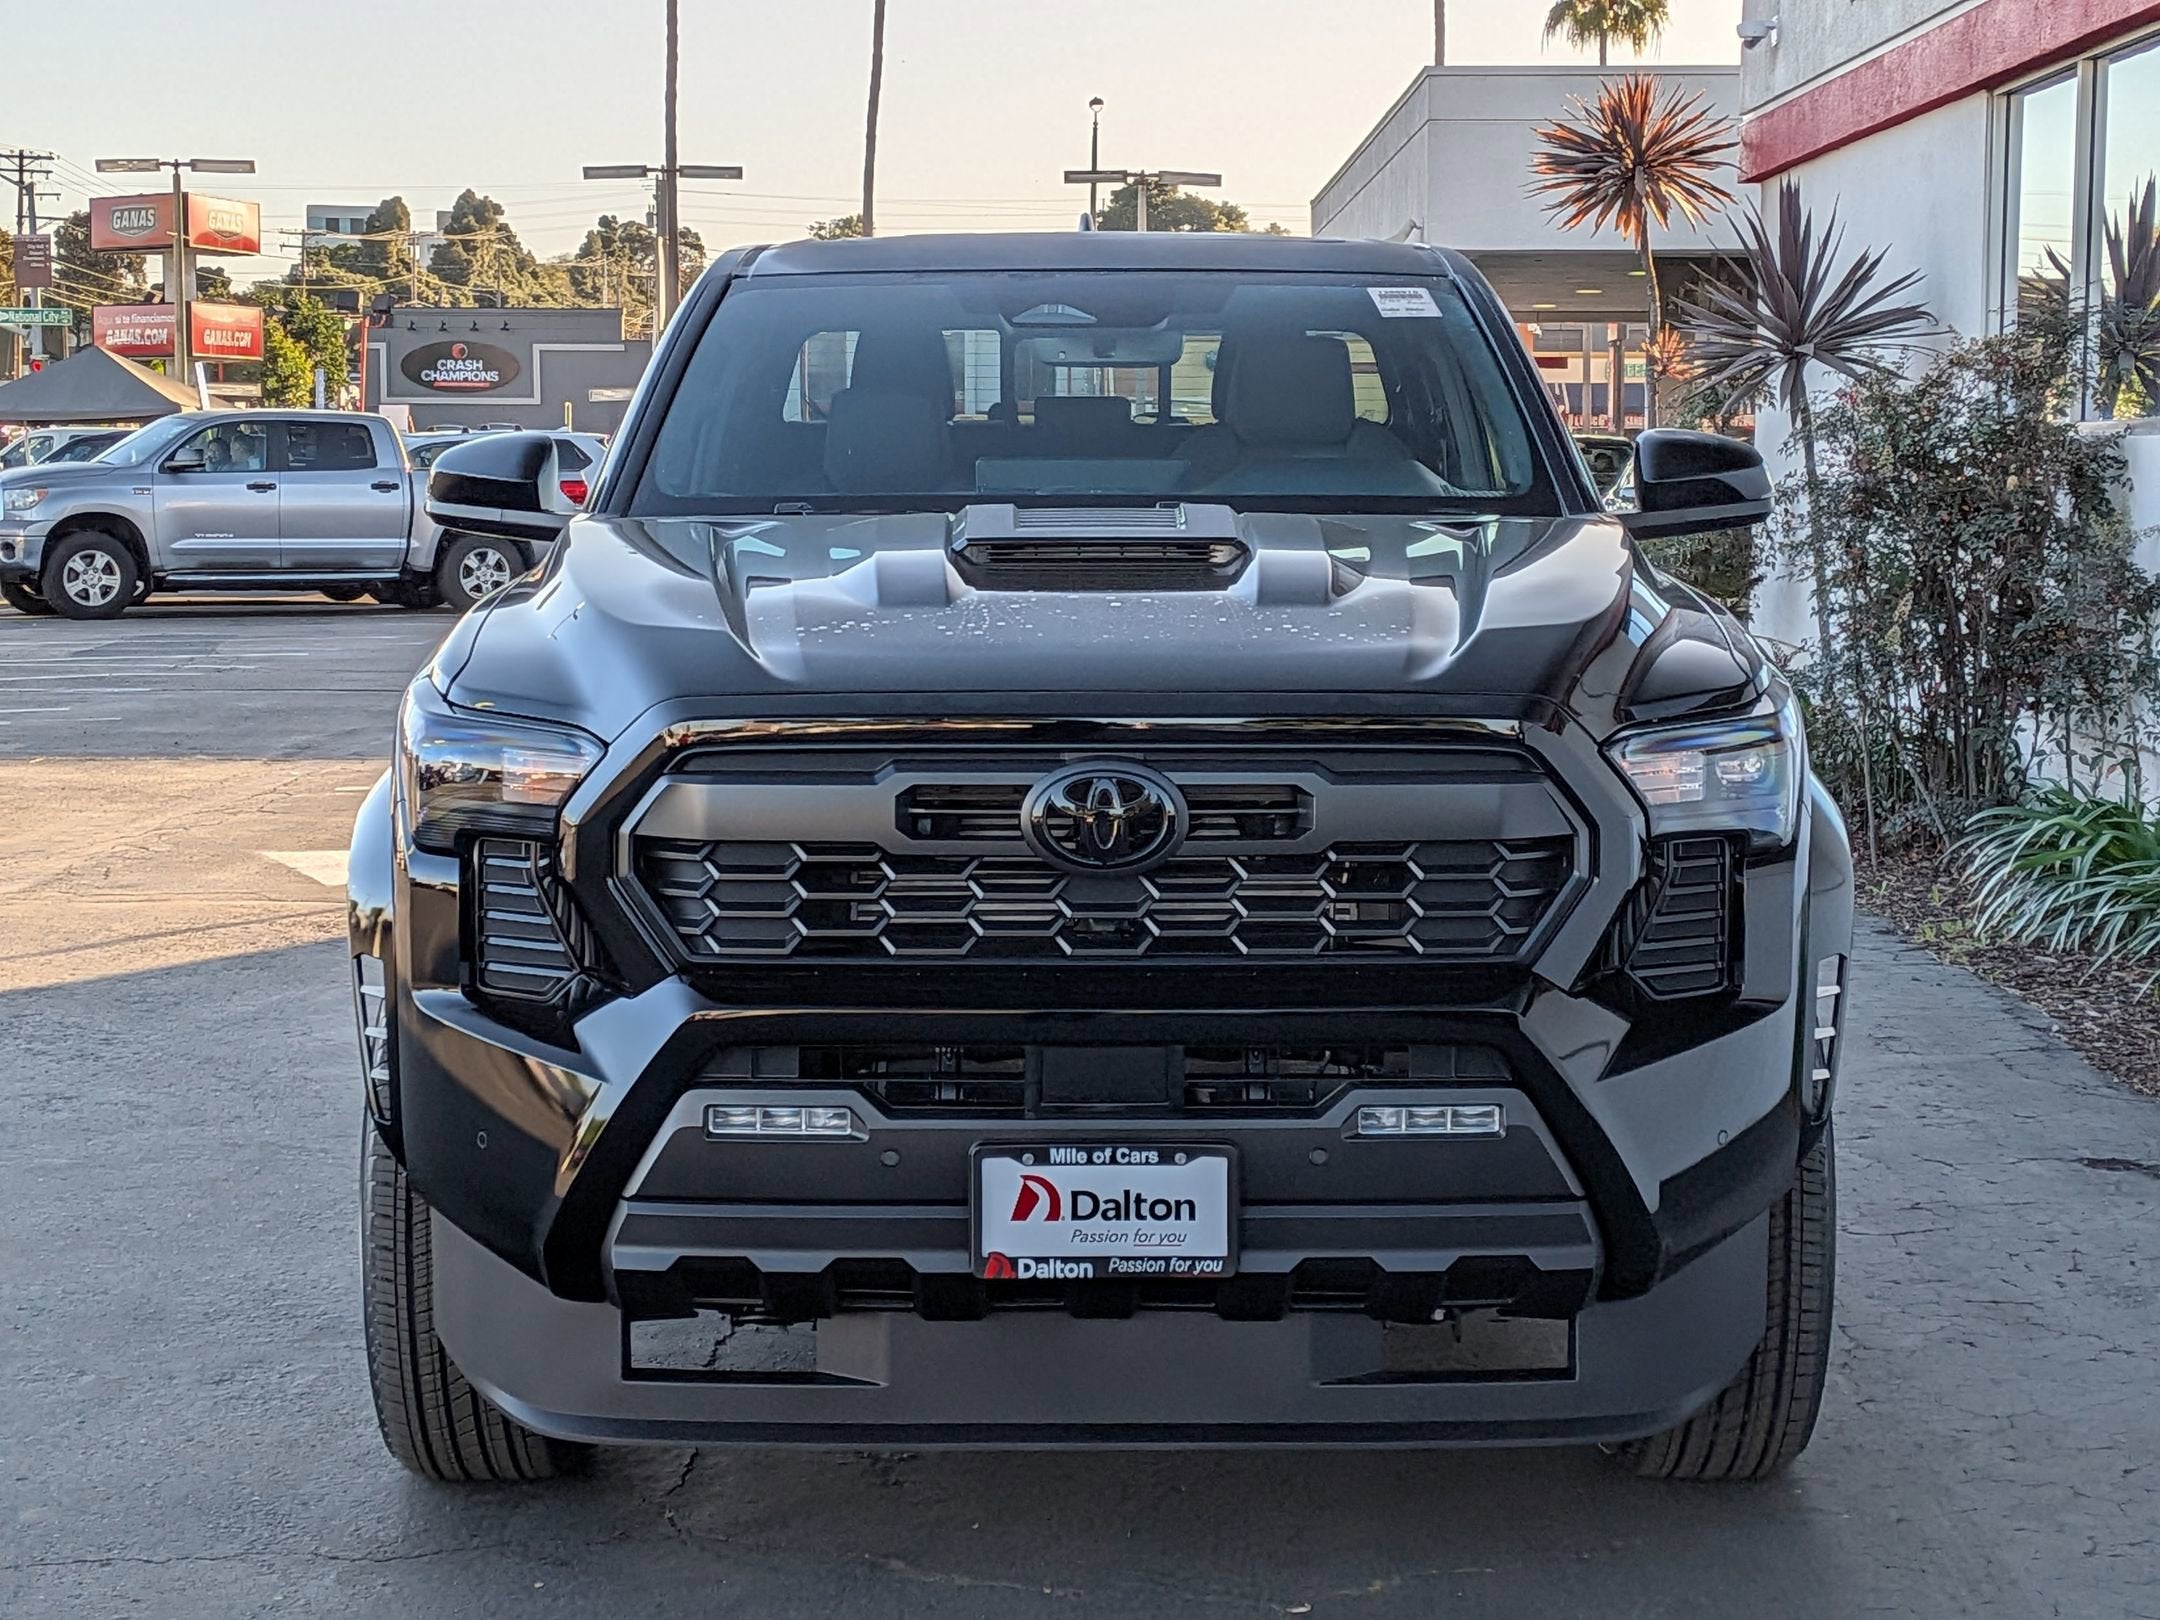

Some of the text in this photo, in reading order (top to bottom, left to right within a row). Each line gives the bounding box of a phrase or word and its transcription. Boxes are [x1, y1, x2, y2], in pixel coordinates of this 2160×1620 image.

[113, 209, 155, 229] GANAS
[208, 211, 243, 232] GANAS
[8, 310, 41, 322] National
[43, 310, 60, 323] City
[106, 328, 168, 346] GANAS.COM
[203, 329, 252, 348] GANAS.COM
[437, 359, 483, 371] CRASH
[420, 370, 499, 382] CHAMPIONS
[1050, 1147, 1160, 1164] Mile of Cars
[1070, 1189, 1197, 1222] Dalton
[1070, 1228, 1188, 1245] Passion for you
[1018, 1258, 1094, 1280] Dalton
[1107, 1256, 1224, 1276] Passion for you
